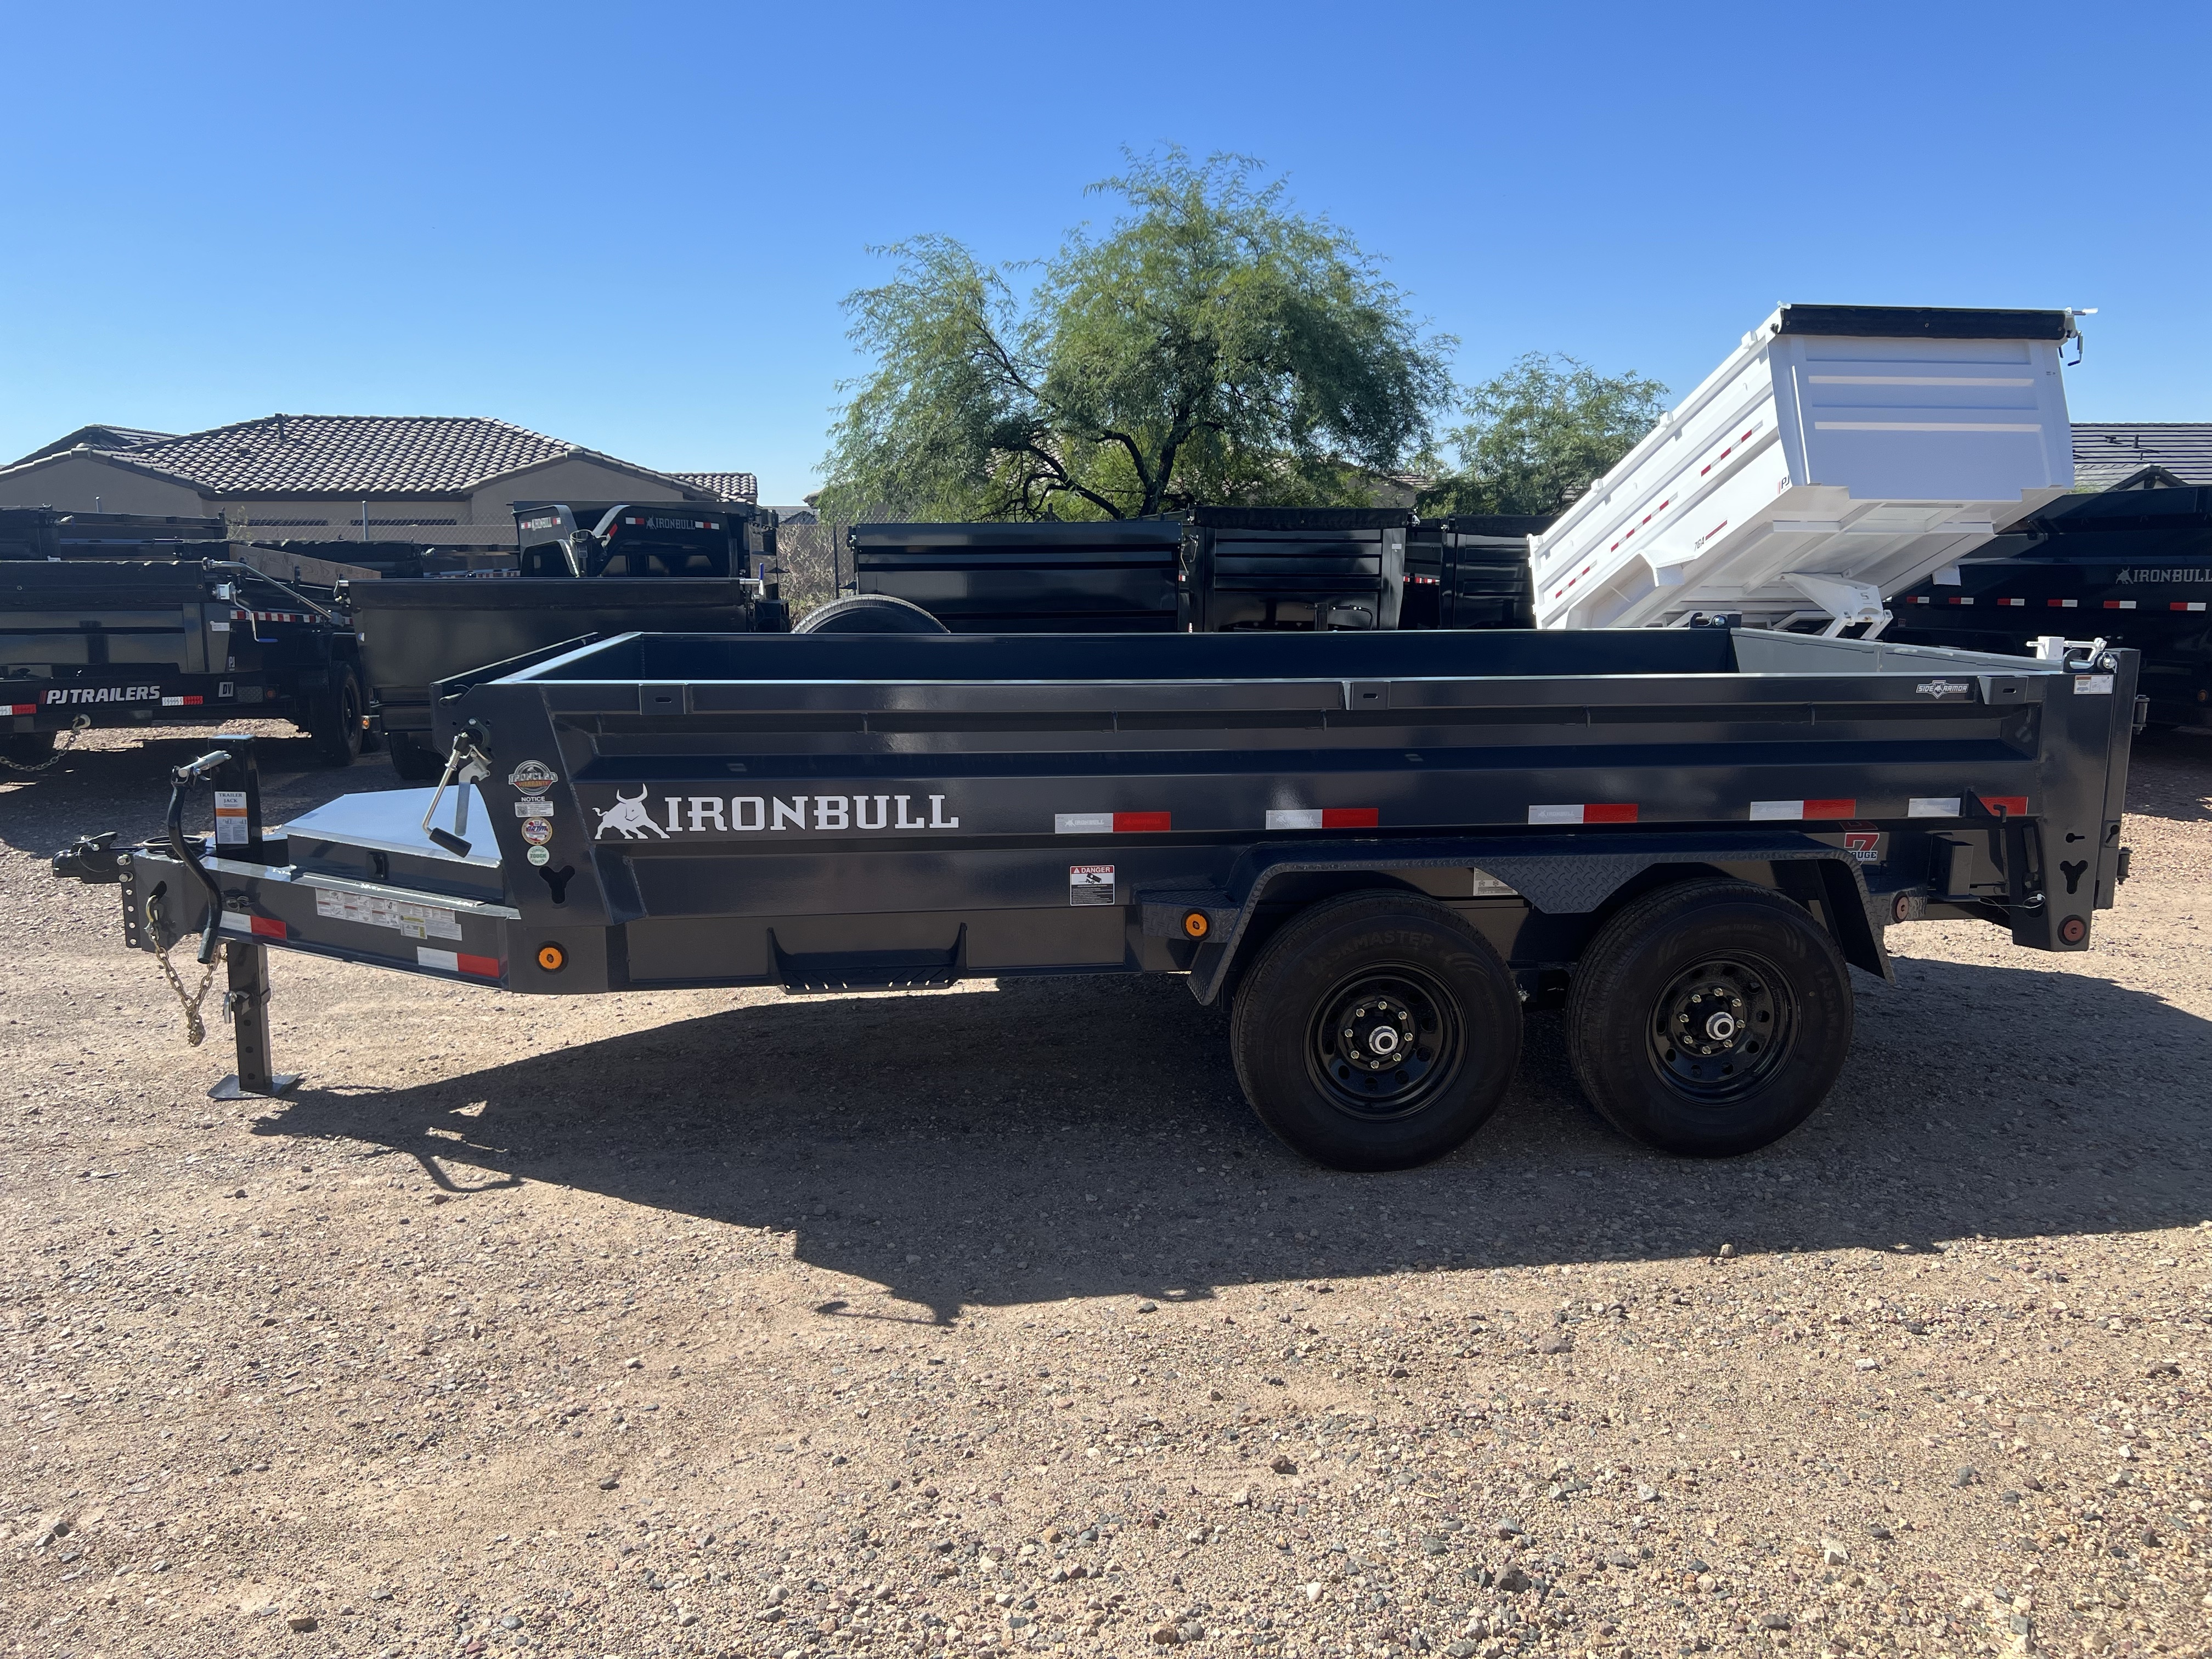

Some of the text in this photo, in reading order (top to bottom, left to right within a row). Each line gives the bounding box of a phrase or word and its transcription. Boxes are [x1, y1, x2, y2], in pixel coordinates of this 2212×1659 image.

[1781, 475, 1790, 489] PJ
[656, 517, 696, 530] IRONBULL
[2134, 569, 2212, 582] IRONBULL
[223, 684, 232, 695] DV
[665, 795, 959, 831] IRONBULL
[1844, 832, 1880, 865] 7
[1304, 929, 1434, 977] TASKMASTER
